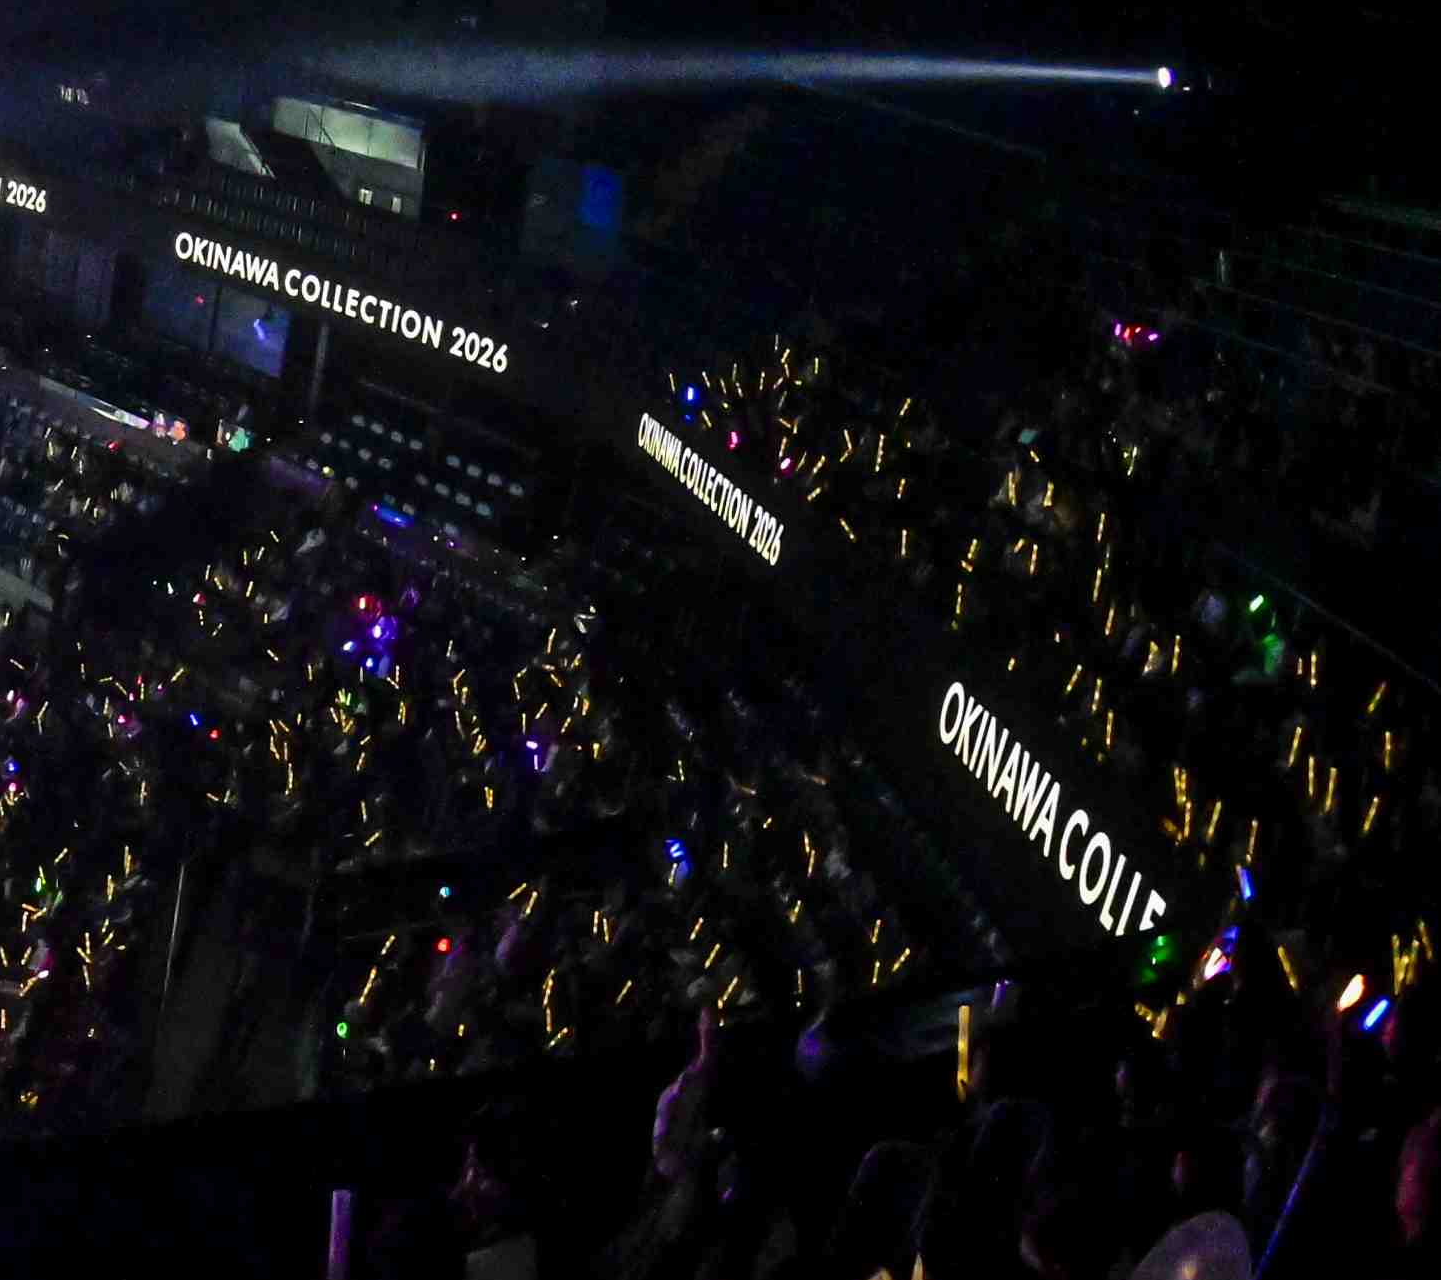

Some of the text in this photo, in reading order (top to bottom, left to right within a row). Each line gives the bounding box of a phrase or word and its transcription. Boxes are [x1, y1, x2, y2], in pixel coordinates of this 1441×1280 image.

[5, 180, 47, 213] 2026
[174, 232, 508, 373] OKINAWA COLLECTION 2026
[638, 412, 784, 566] OKINAWA COLLECTION 2026
[939, 681, 1061, 858] OKINAWA
